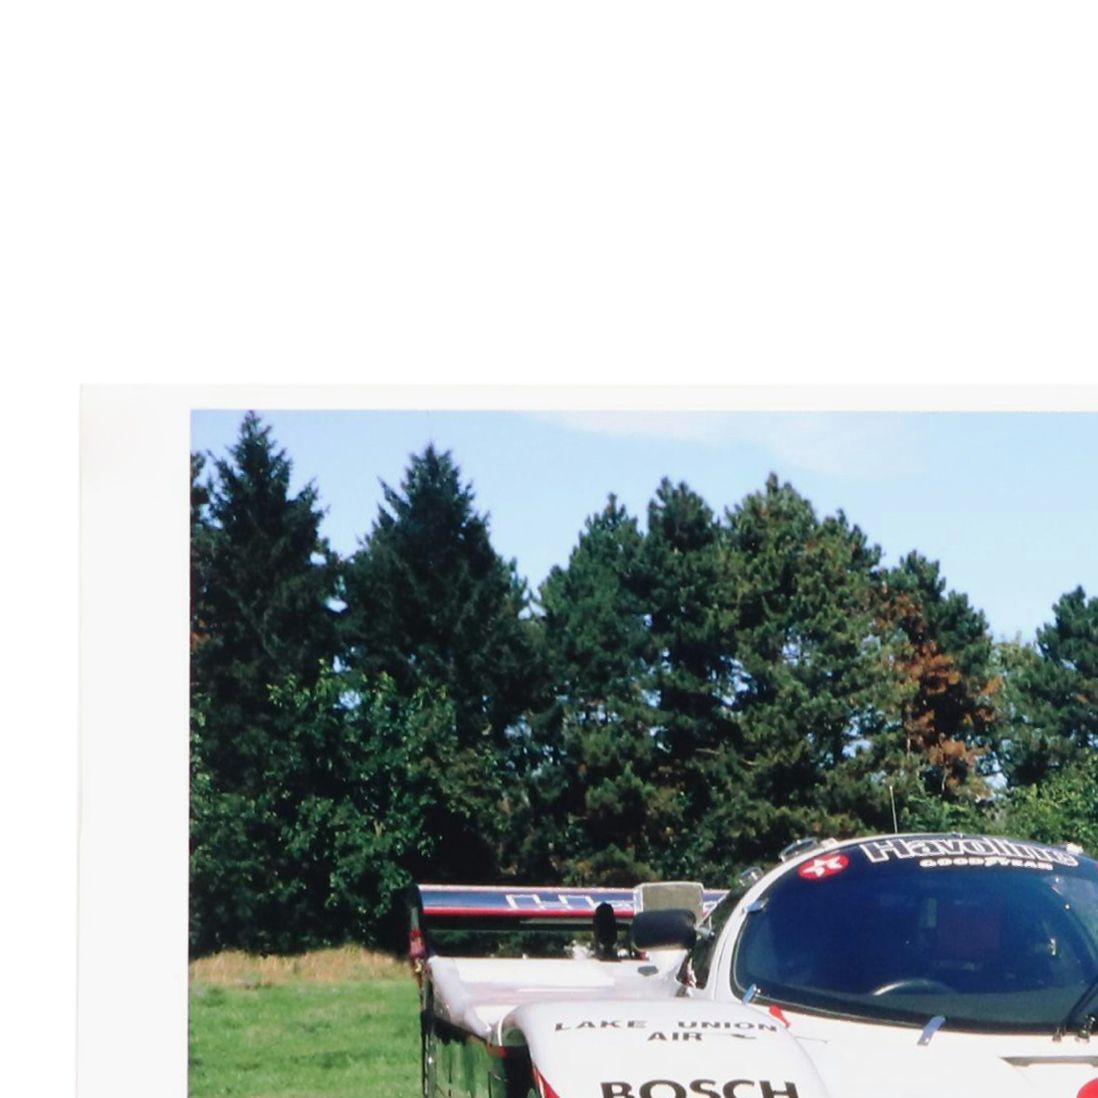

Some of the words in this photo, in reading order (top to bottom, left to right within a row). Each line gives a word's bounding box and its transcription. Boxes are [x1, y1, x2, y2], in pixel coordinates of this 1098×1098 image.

[859, 837, 1079, 866] Havoline
[919, 856, 1054, 870] GOODYEAR
[555, 1020, 647, 1031] LAKE
[678, 1020, 778, 1032] UNION
[647, 1031, 703, 1041] AIR
